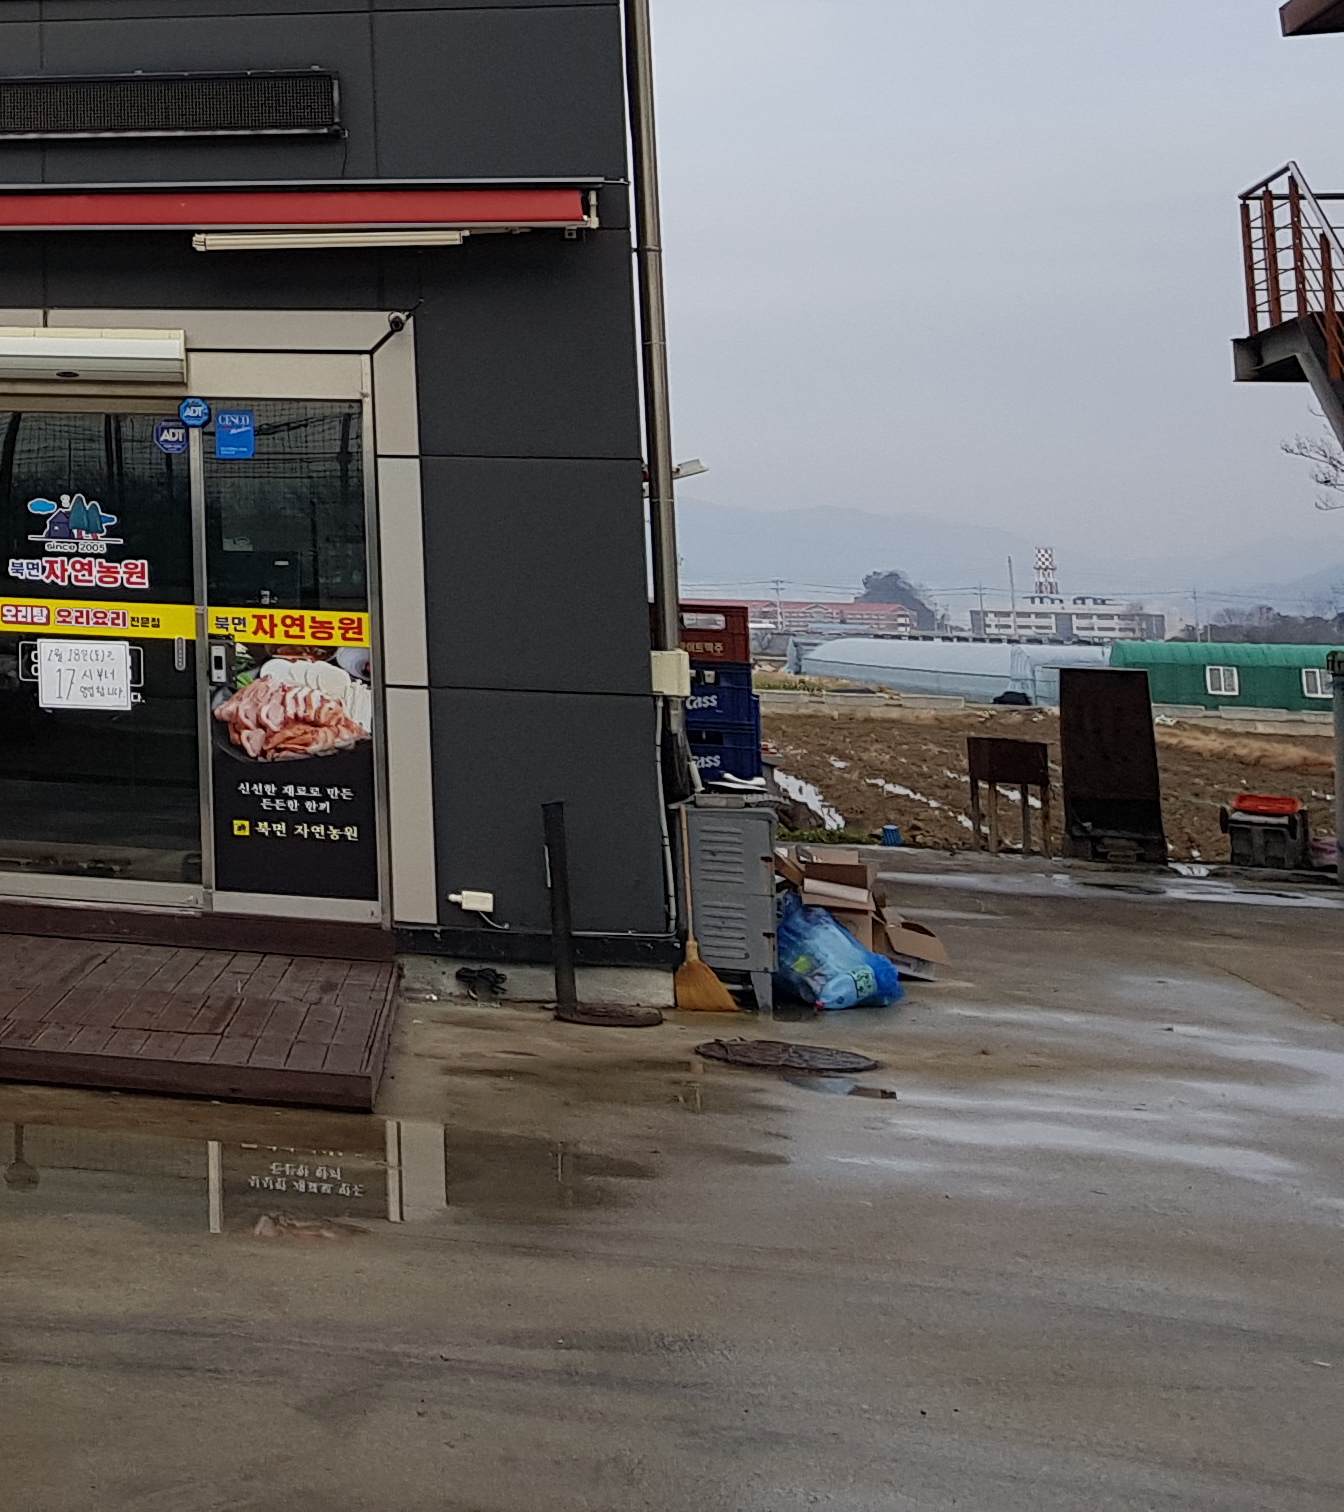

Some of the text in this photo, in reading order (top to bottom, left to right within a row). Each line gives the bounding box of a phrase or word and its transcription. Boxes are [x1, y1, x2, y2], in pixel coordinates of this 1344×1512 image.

[183, 406, 204, 417] ADT
[160, 428, 185, 442] ADT
[46, 541, 106, 553] since 2005
[10, 558, 148, 587] 북면 자연농원
[1, 605, 49, 624] 오리탕
[55, 608, 128, 627] 오리요리
[215, 614, 364, 642] 북면 자연농원
[685, 694, 718, 709] Cass
[237, 781, 355, 800] 신선한 재료로 만든
[260, 798, 300, 812] 든든한
[254, 821, 359, 841] 북면 자연농원
